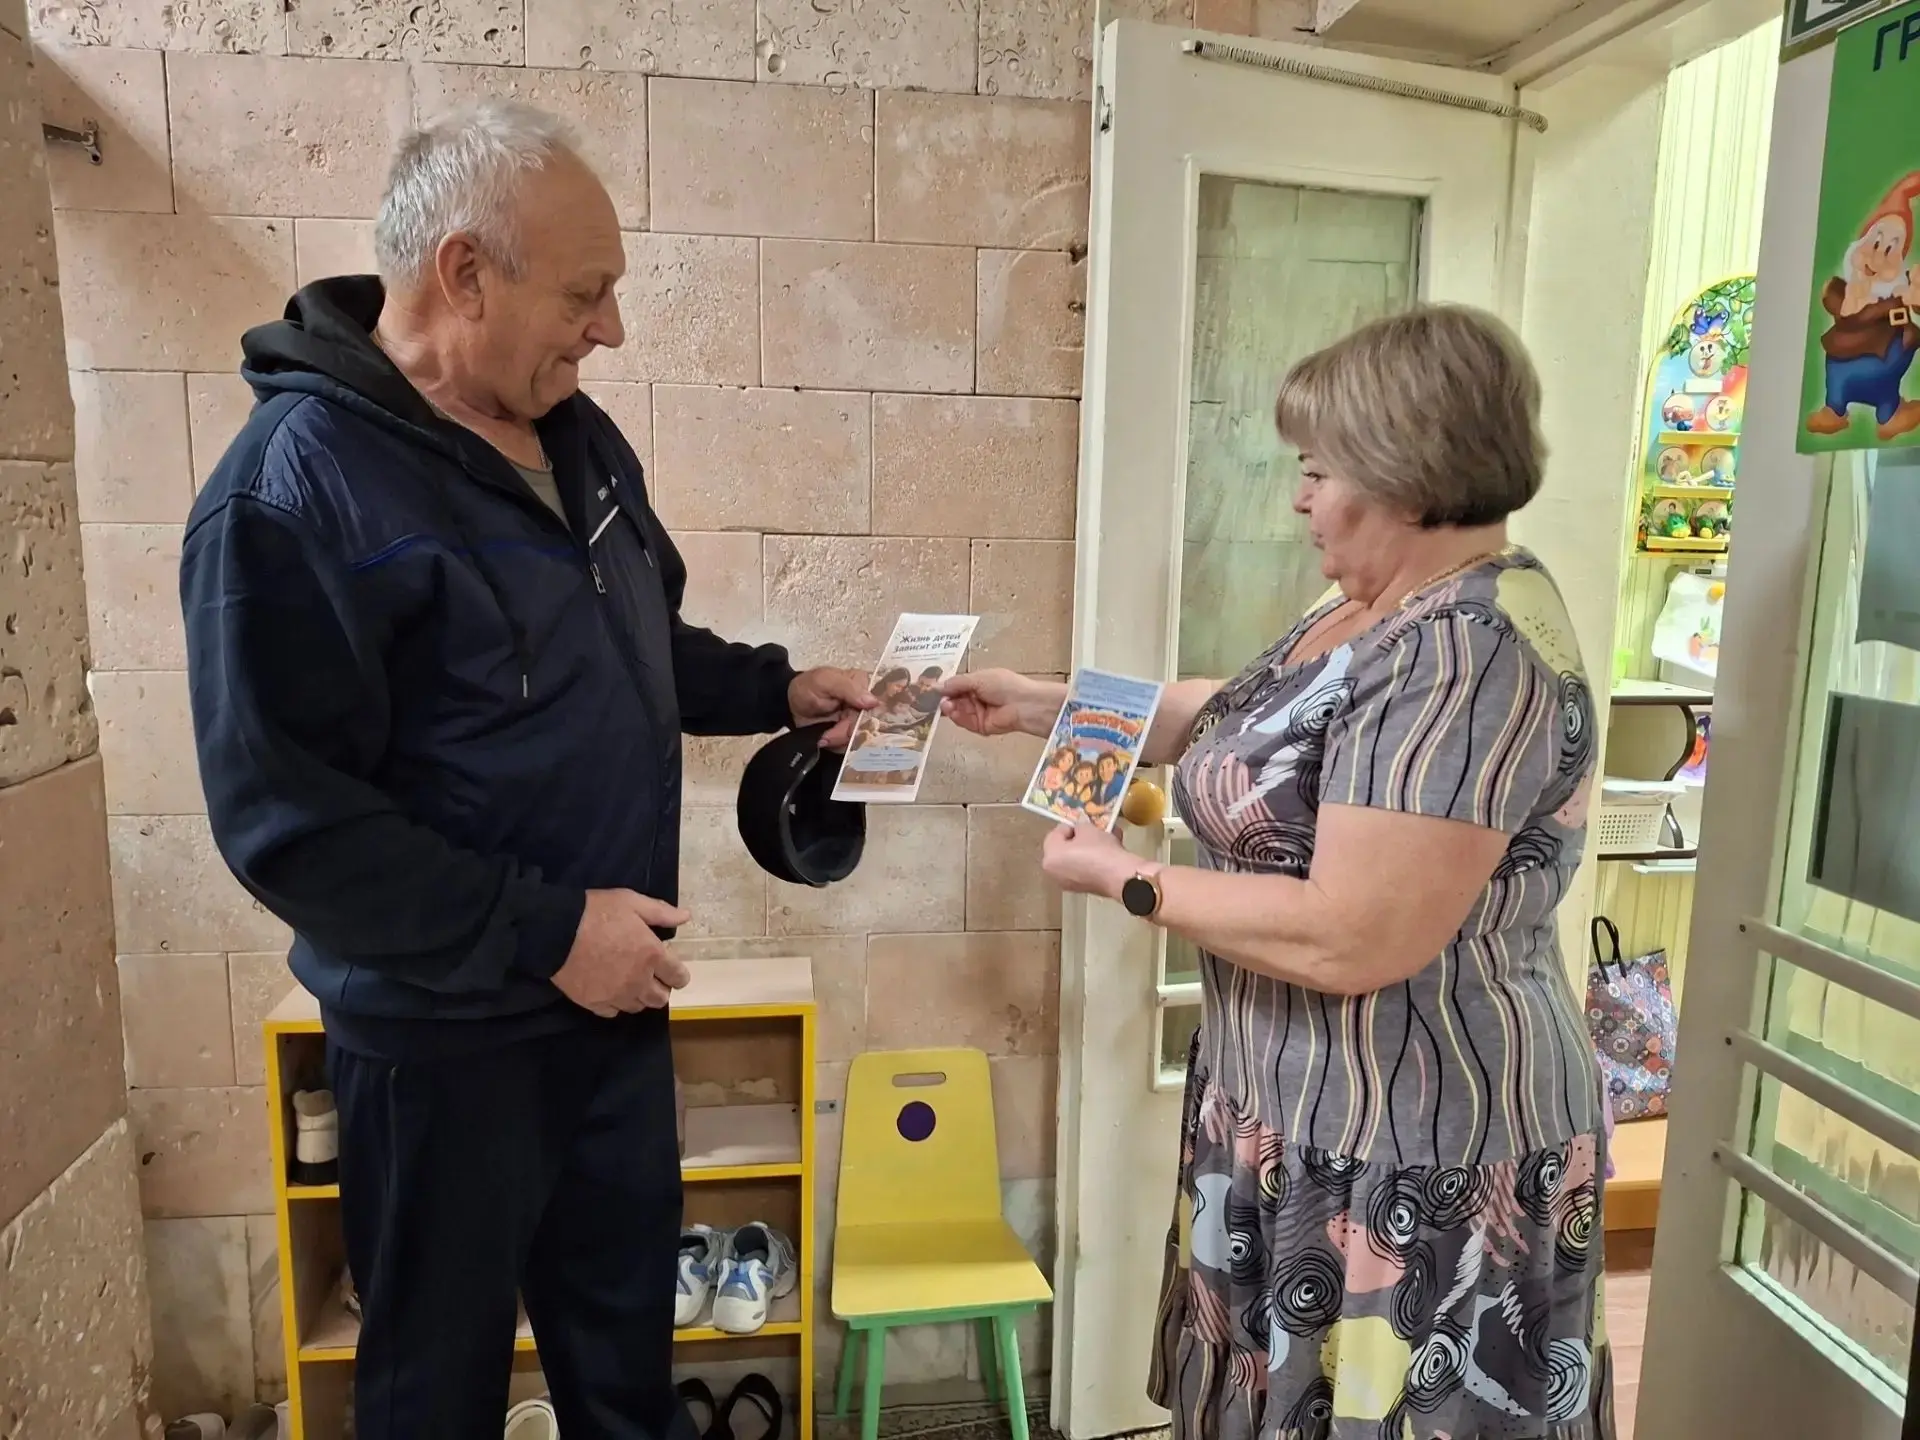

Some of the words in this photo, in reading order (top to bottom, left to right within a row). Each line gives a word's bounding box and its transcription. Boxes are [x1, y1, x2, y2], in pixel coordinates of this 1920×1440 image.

[900, 634, 931, 643] Жизнь
[932, 632, 961, 642] детей
[943, 641, 960, 650] Вас
